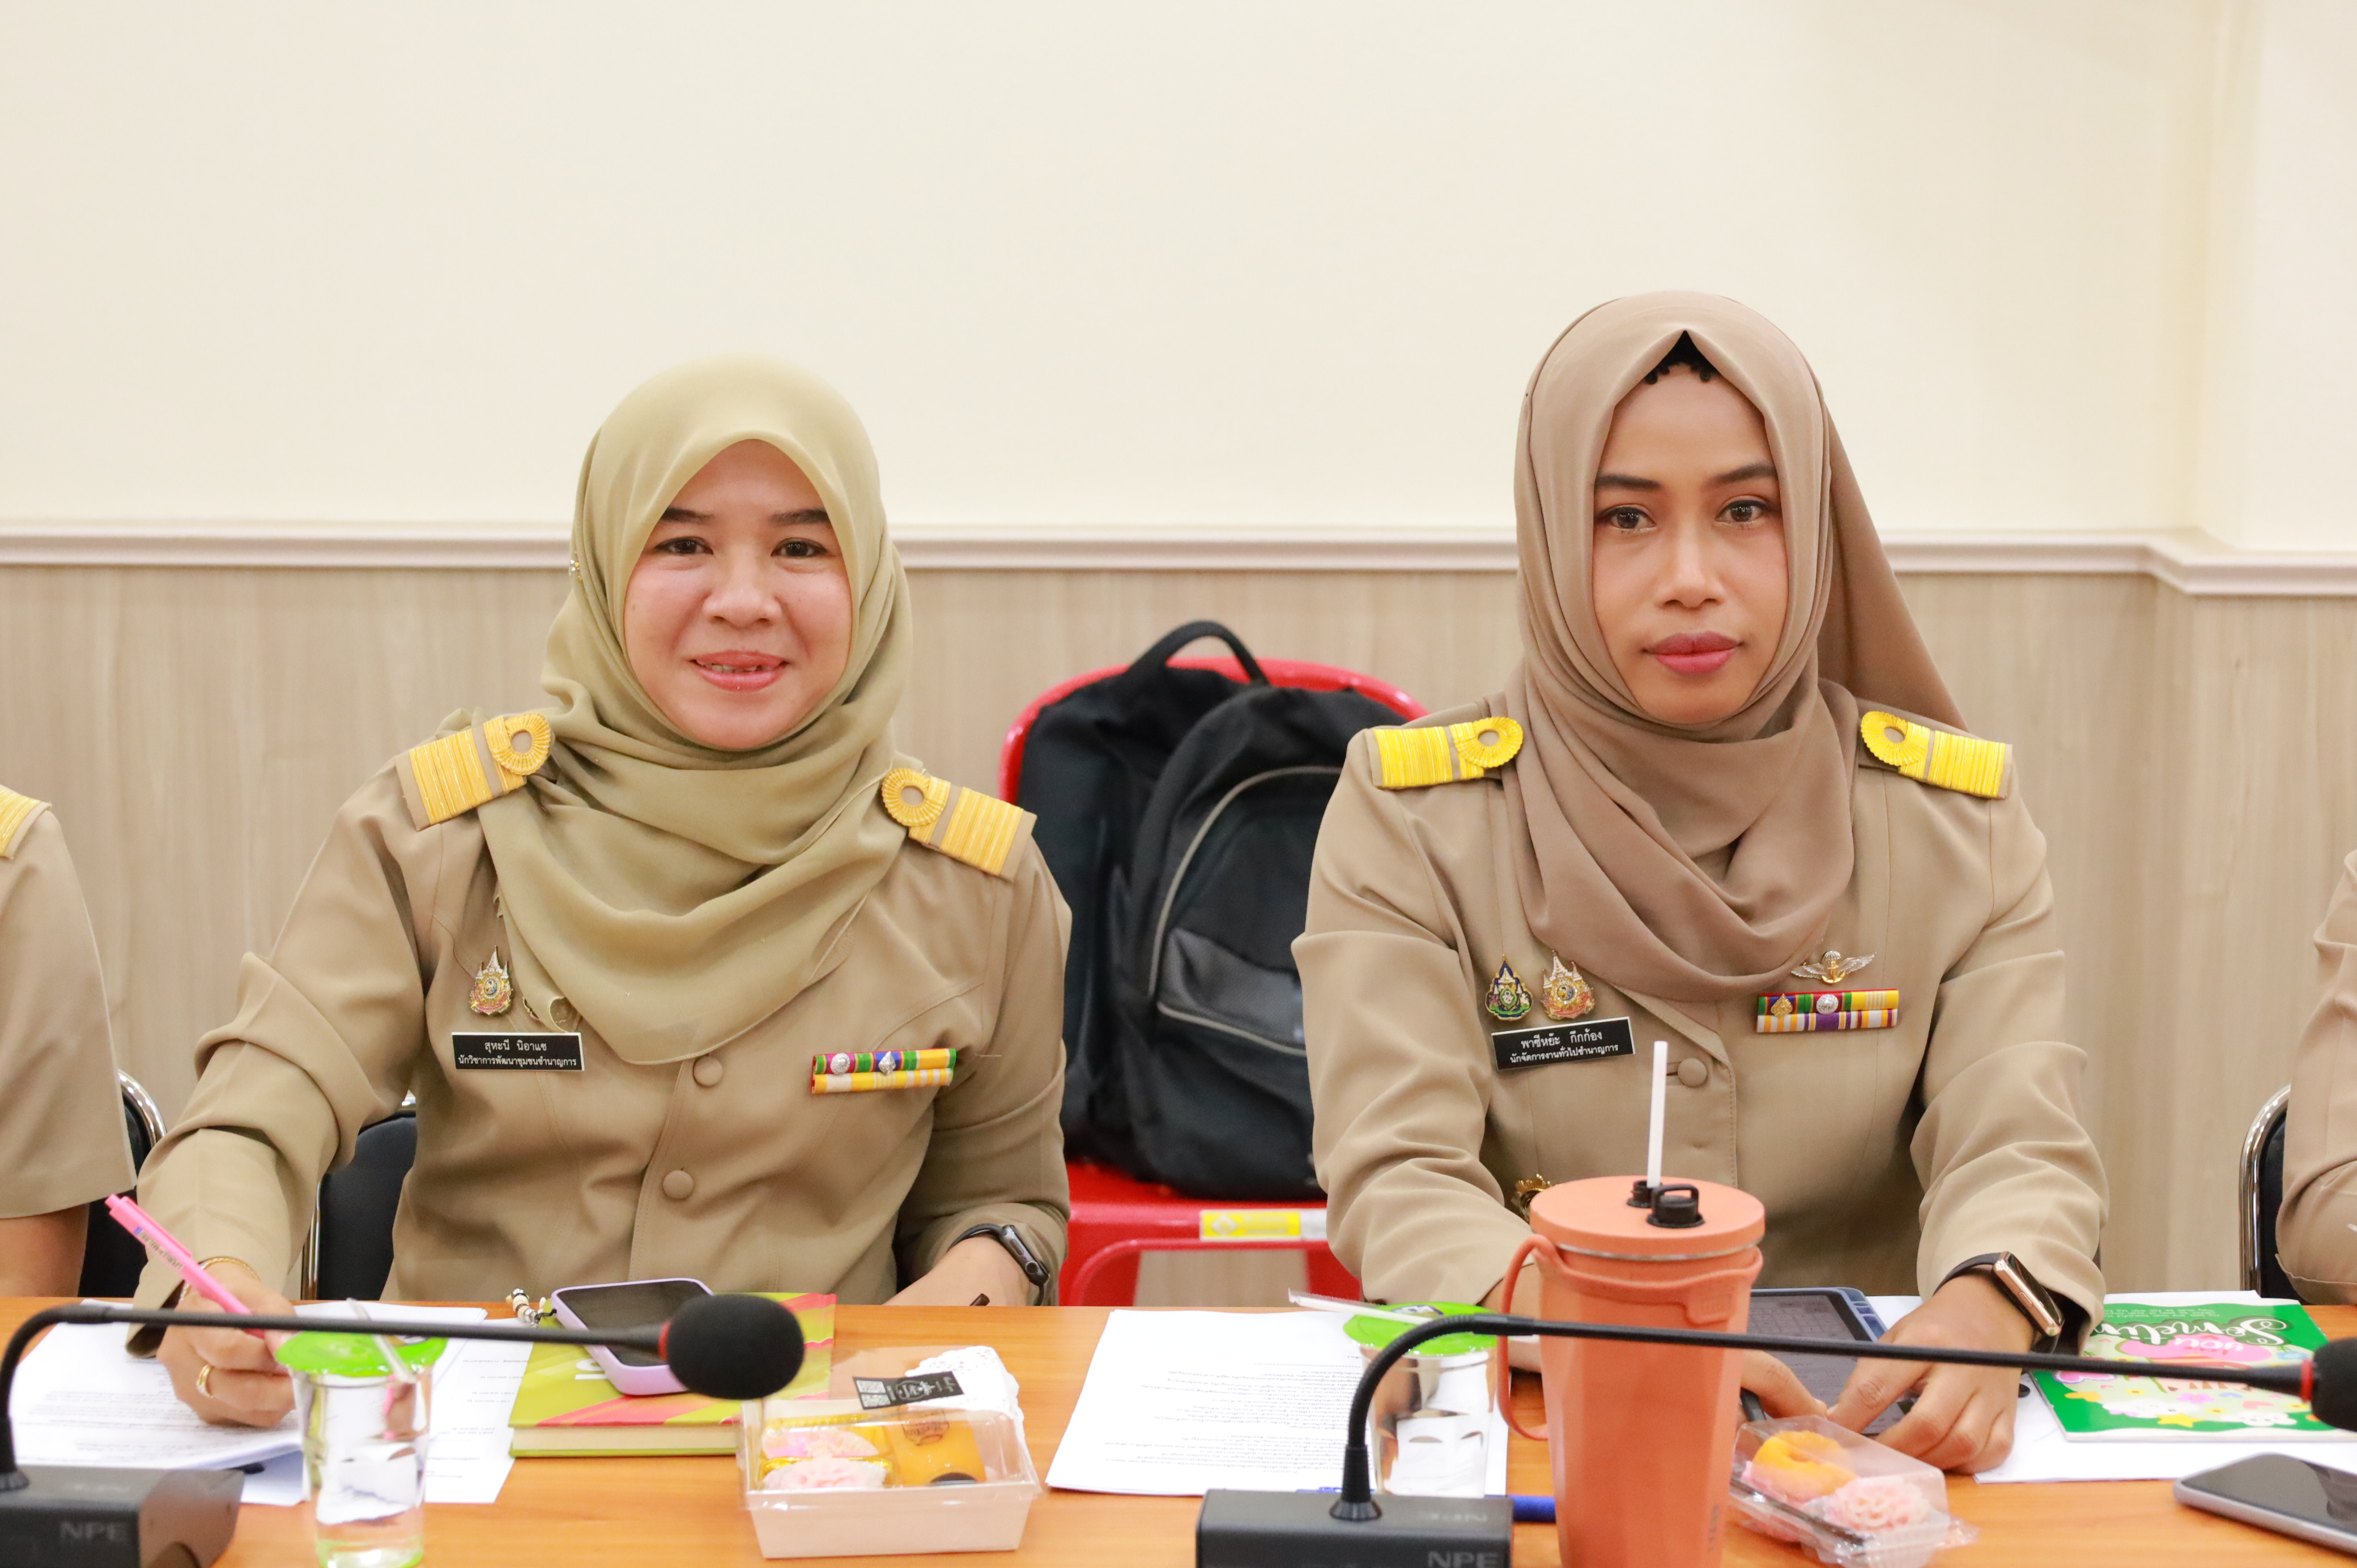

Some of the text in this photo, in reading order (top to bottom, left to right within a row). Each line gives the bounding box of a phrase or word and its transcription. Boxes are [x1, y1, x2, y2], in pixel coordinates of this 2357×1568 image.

[458, 1054, 577, 1068] นักวิชาการพัฒนาชุมชนชำนาญการ
[1510, 1045, 1618, 1063] นักจัดการงานทั่วไปชำนาญการ
[60, 1521, 128, 1541] NPE
[1428, 1551, 1499, 1568] NPE
